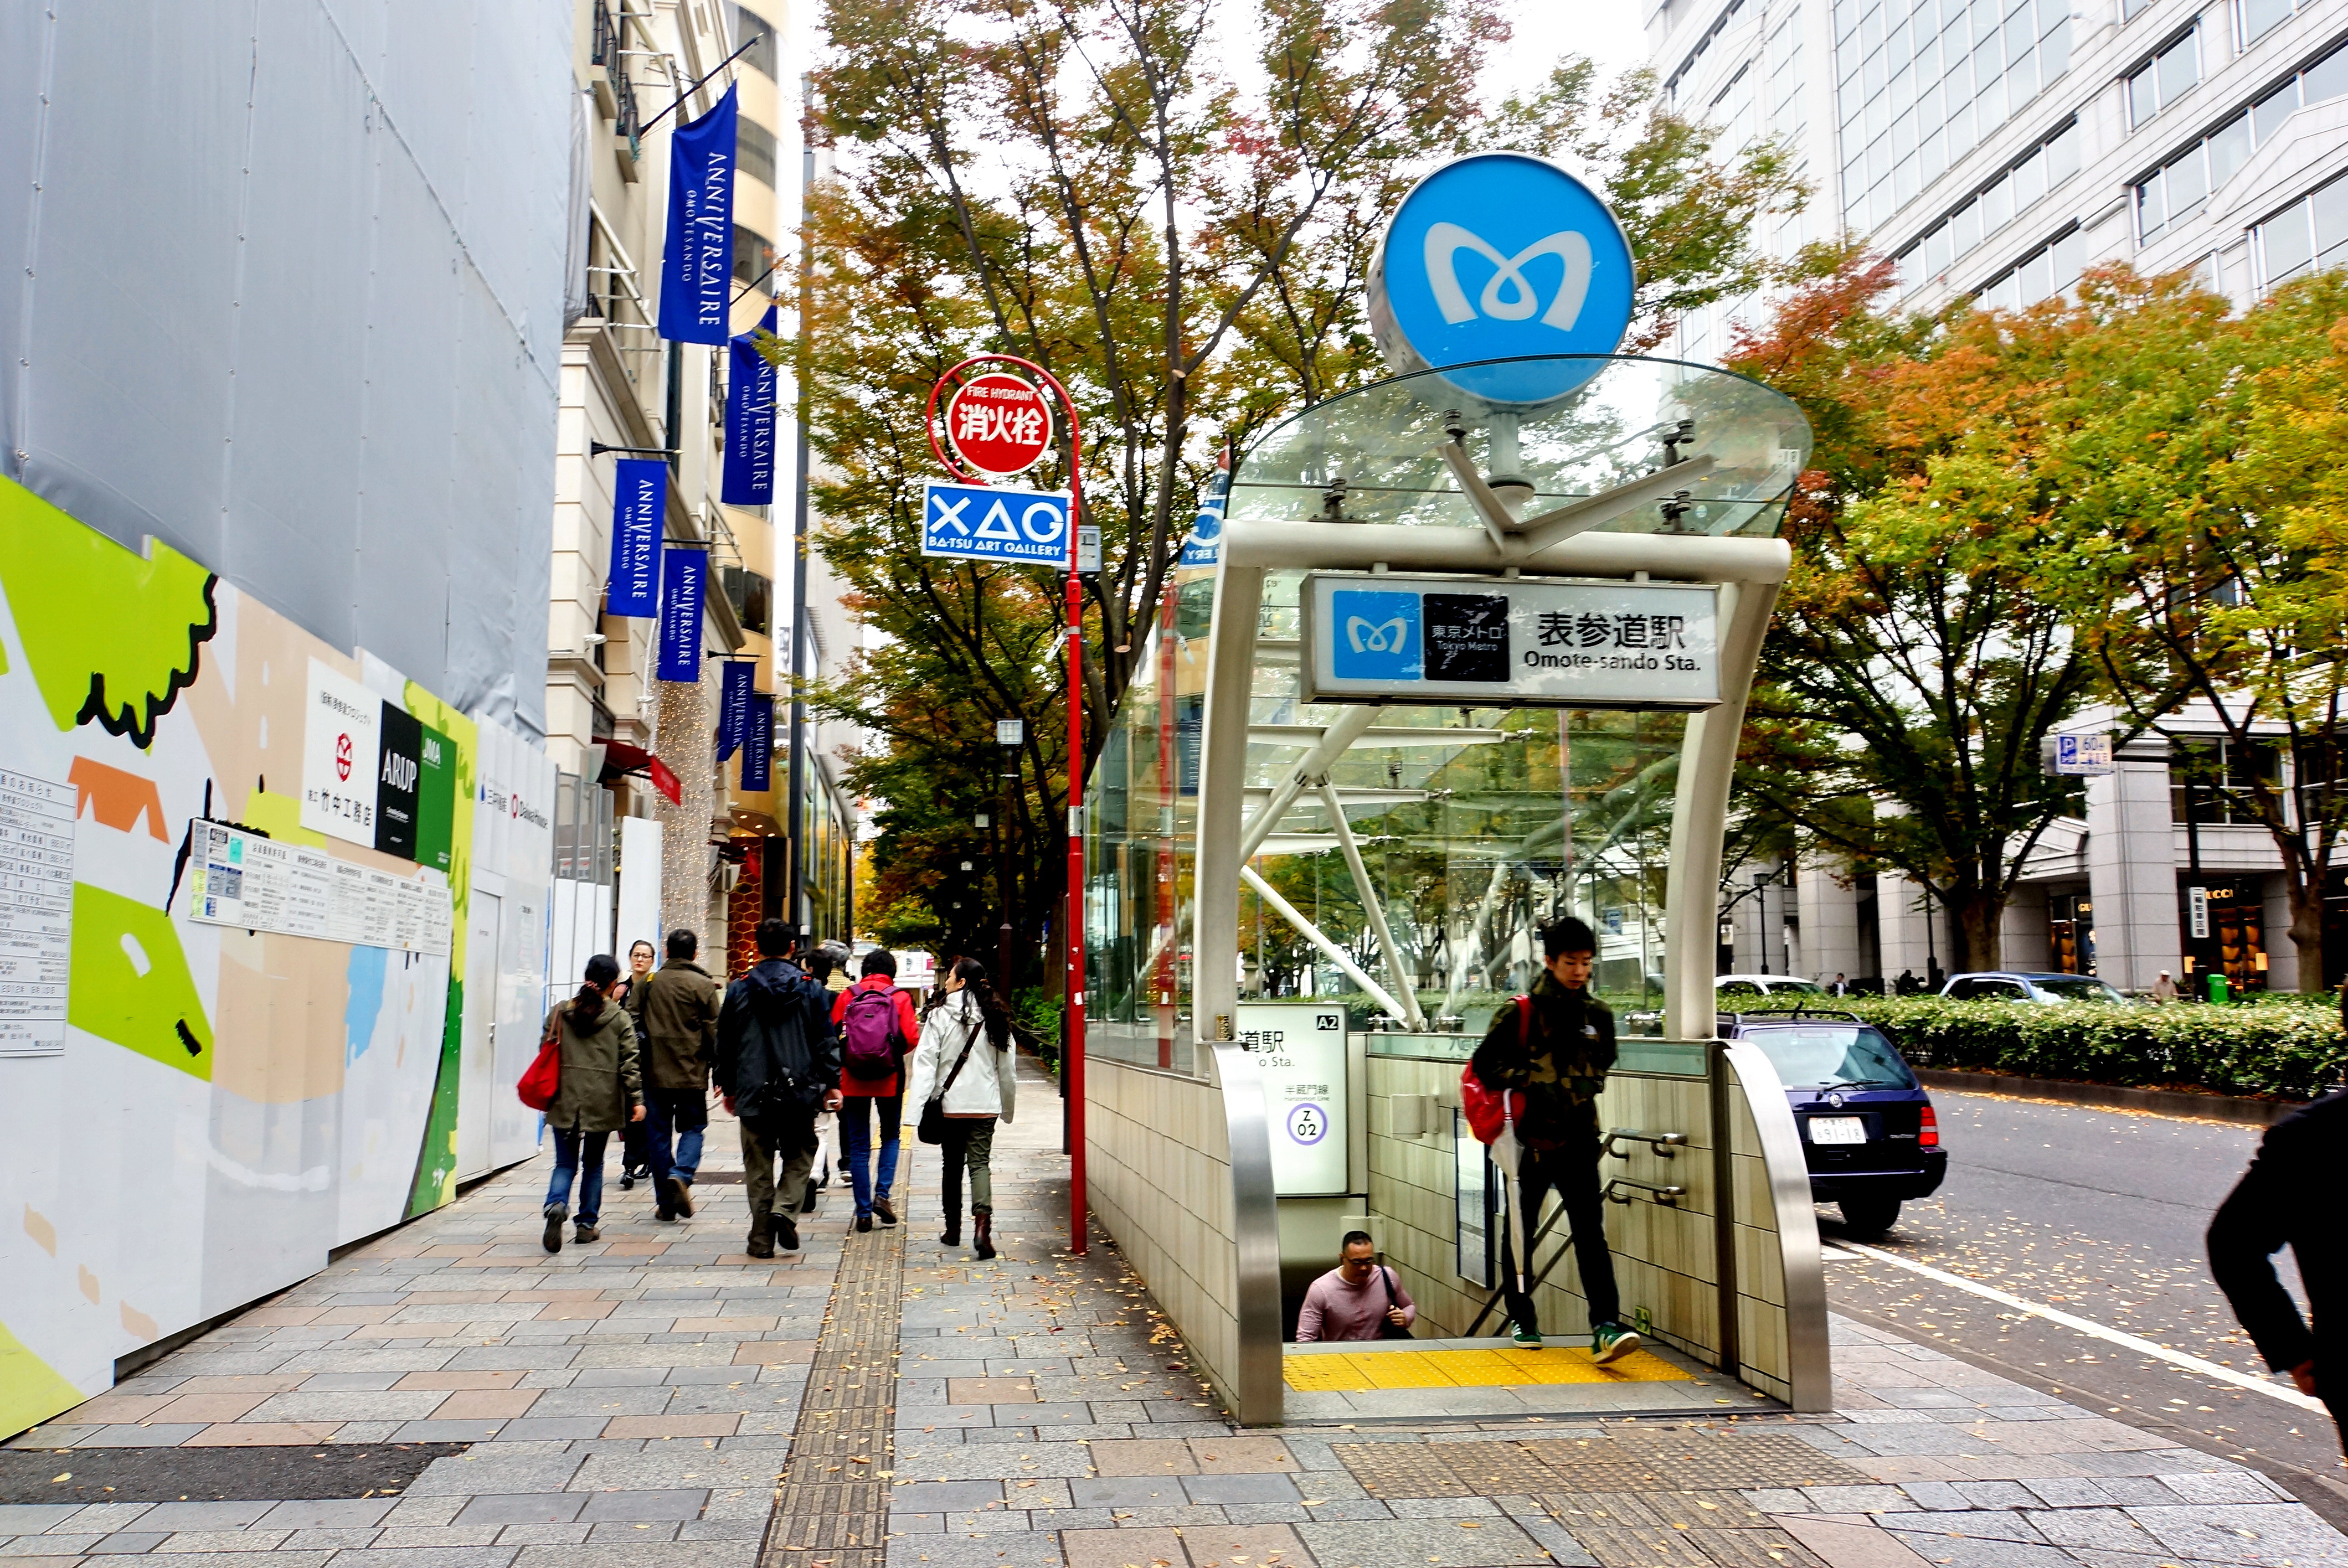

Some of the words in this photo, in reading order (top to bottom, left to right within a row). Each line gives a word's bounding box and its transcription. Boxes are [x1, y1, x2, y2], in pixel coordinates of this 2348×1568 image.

[682, 190, 697, 282] OMOTESANDO
[695, 152, 728, 326] ANNIVERSAIRE
[967, 386, 989, 398] FIRE
[990, 388, 1035, 401] HYDRANT
[958, 403, 1043, 445] 消火栓
[621, 507, 632, 569] OMOTESANDO
[629, 479, 654, 599] ANNIVERSAIRE
[928, 536, 972, 550] BA-TSU
[975, 540, 1001, 552] ART
[1004, 543, 1062, 556] GALLERY
[675, 565, 697, 666] ANNIVERSAIRE
[1432, 625, 1502, 639] 東京メトロ
[1537, 611, 1686, 649] 表参道駅
[1435, 641, 1466, 653] Tokyo
[1468, 642, 1498, 651] Metro
[1524, 650, 1659, 670] Omote-sando
[1665, 654, 1702, 671] Sta.
[422, 737, 441, 765] JMA
[2063, 738, 2074, 754] P
[381, 748, 417, 793] ARUP
[2206, 889, 2233, 899] UCCI
[1317, 1017, 1338, 1029] A2
[1238, 1030, 1284, 1053] 道駅
[1272, 1056, 1295, 1067] Sta.
[1285, 1084, 1329, 1095] 半蔵門線
[1302, 1110, 1311, 1122] Z
[1297, 1123, 1317, 1136] 02
